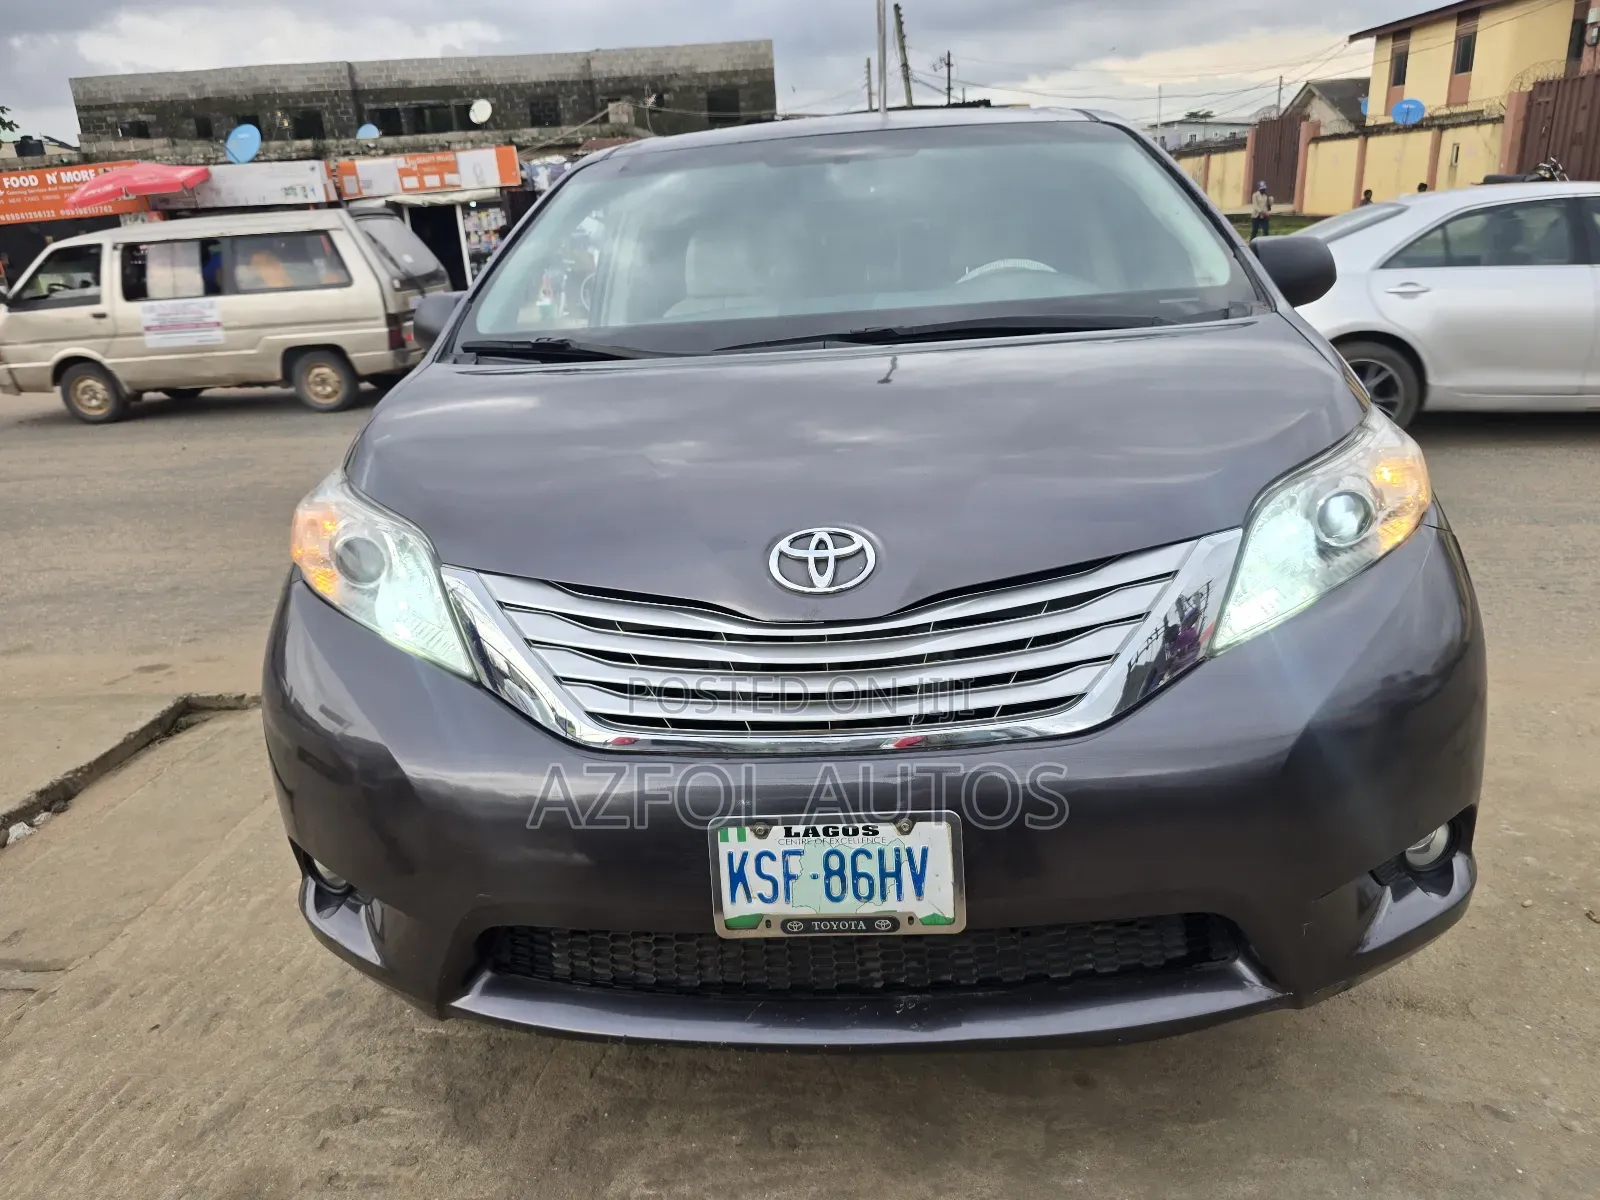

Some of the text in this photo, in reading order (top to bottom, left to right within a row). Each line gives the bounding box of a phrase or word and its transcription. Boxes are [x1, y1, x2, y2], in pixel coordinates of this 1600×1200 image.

[3, 175, 39, 188] FOOD
[60, 169, 96, 183] MORE
[783, 825, 880, 838] LAGOS
[777, 836, 887, 846] CENTRE OF EXCELLENCE
[812, 920, 867, 931] TOYOTA
